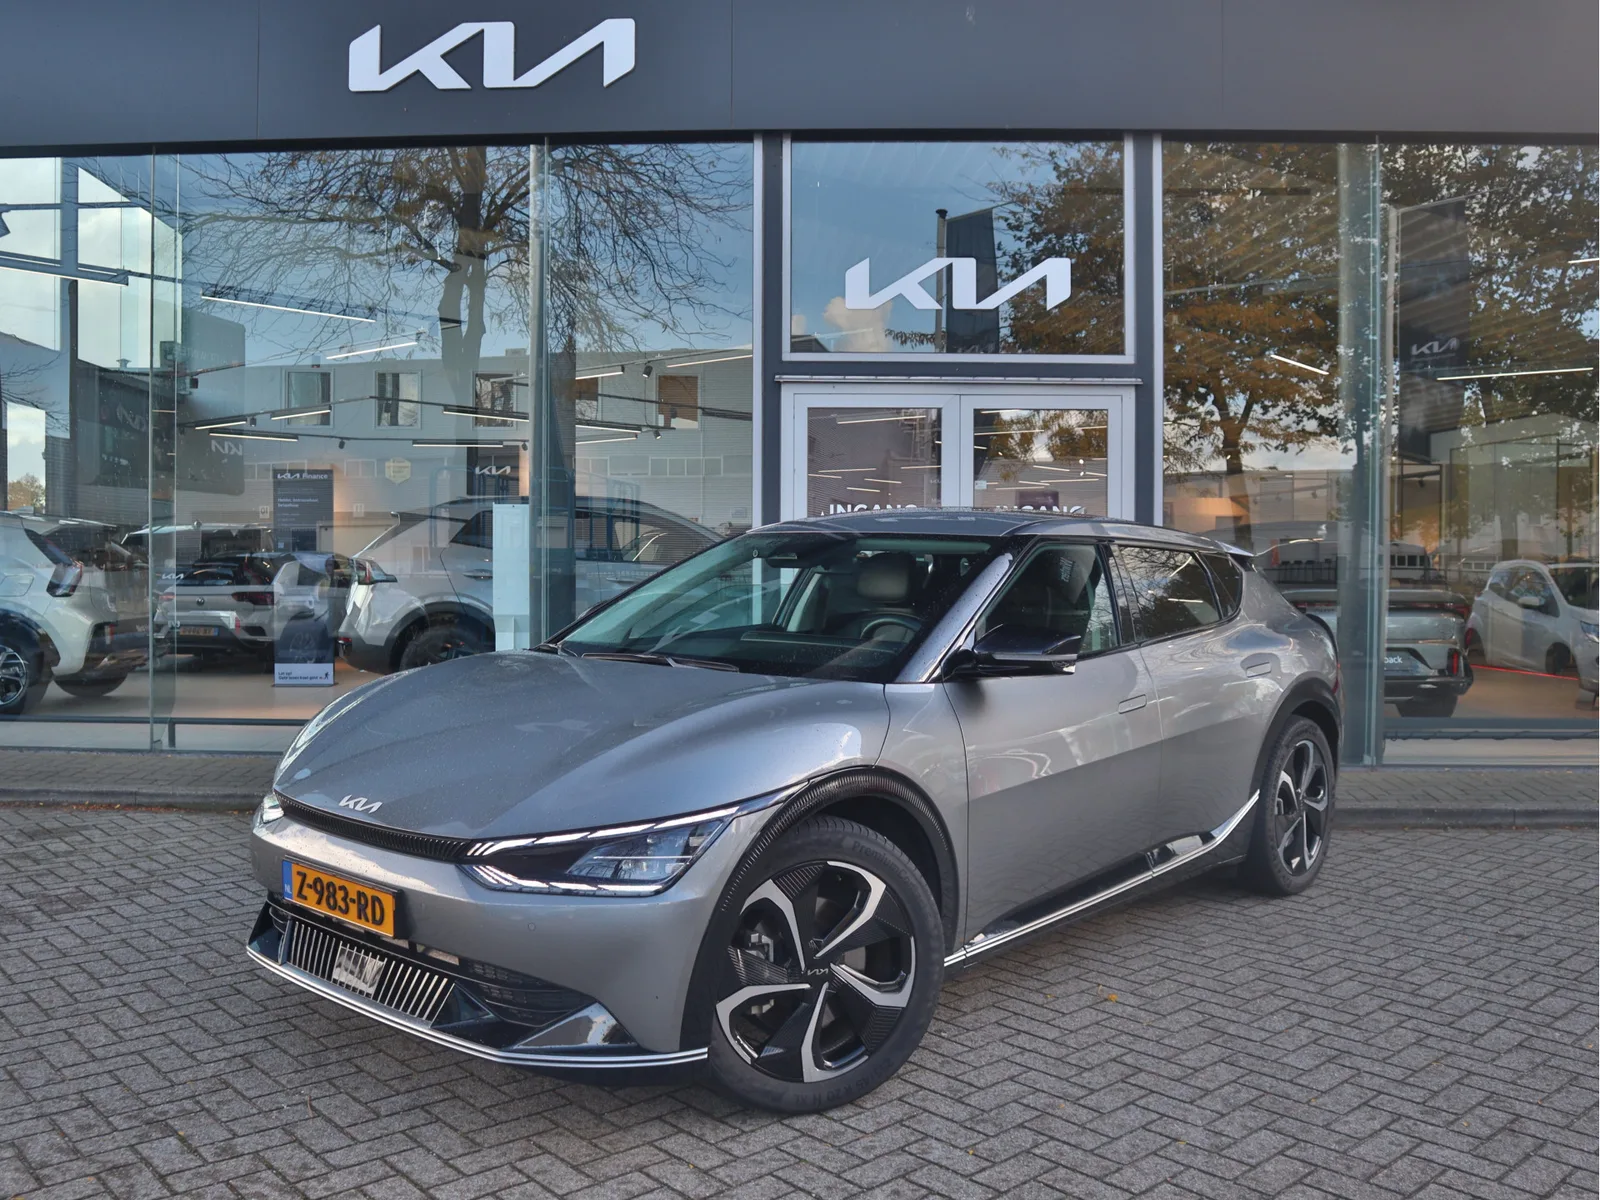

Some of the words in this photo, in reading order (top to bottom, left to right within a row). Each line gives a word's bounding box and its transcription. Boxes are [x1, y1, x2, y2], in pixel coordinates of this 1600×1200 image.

[348, 18, 636, 92] KIA
[845, 257, 1072, 311] KIA
[339, 794, 383, 814] KIA
[296, 870, 385, 926] Z-983-RD
